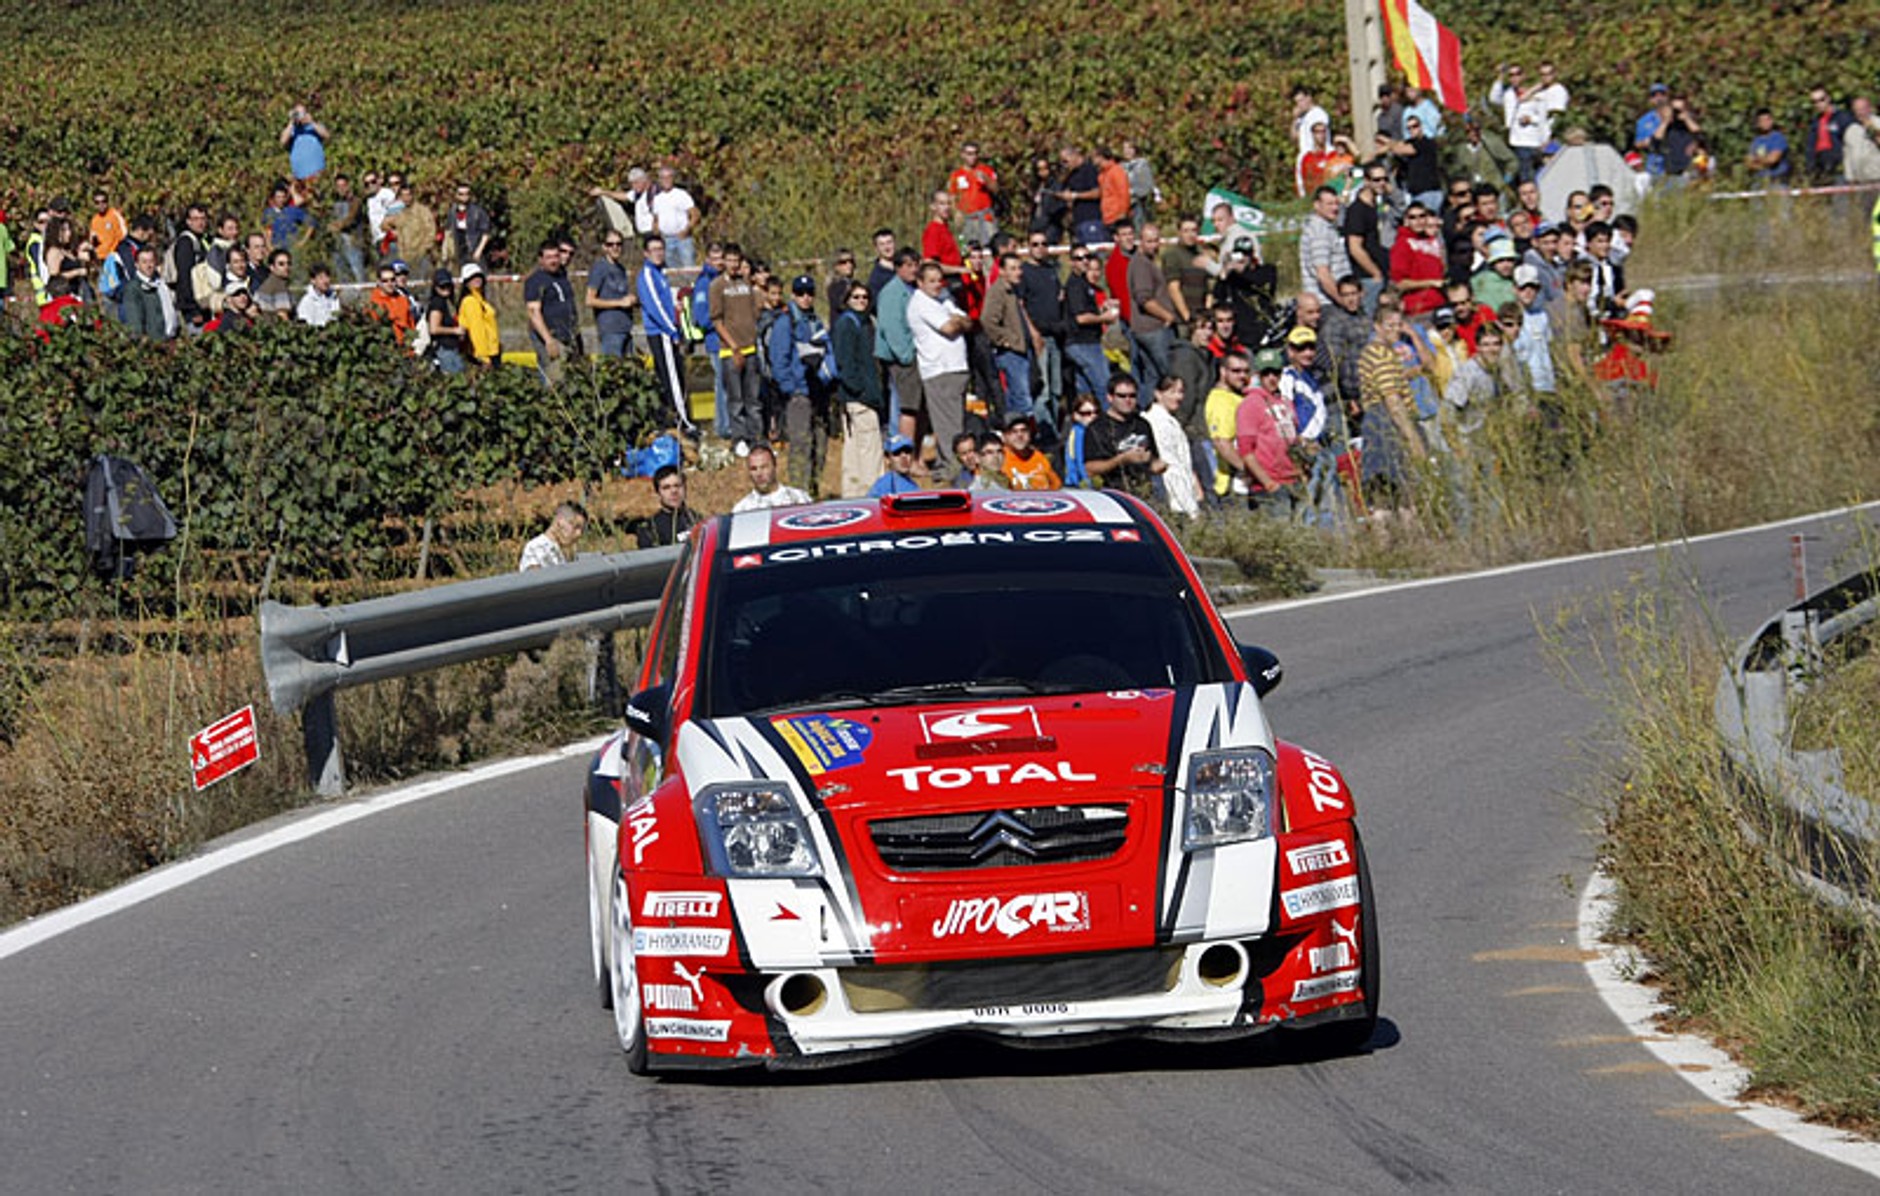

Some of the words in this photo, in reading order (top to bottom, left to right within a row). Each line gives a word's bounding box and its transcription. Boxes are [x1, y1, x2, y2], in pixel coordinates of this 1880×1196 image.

[1023, 529, 1105, 542] C2
[886, 762, 1097, 791] TOTAL
[1286, 839, 1350, 875] PIRELLI
[642, 891, 722, 918] PIRELLI
[1309, 942, 1351, 974] PUMA
[643, 983, 694, 1011] PUMA
